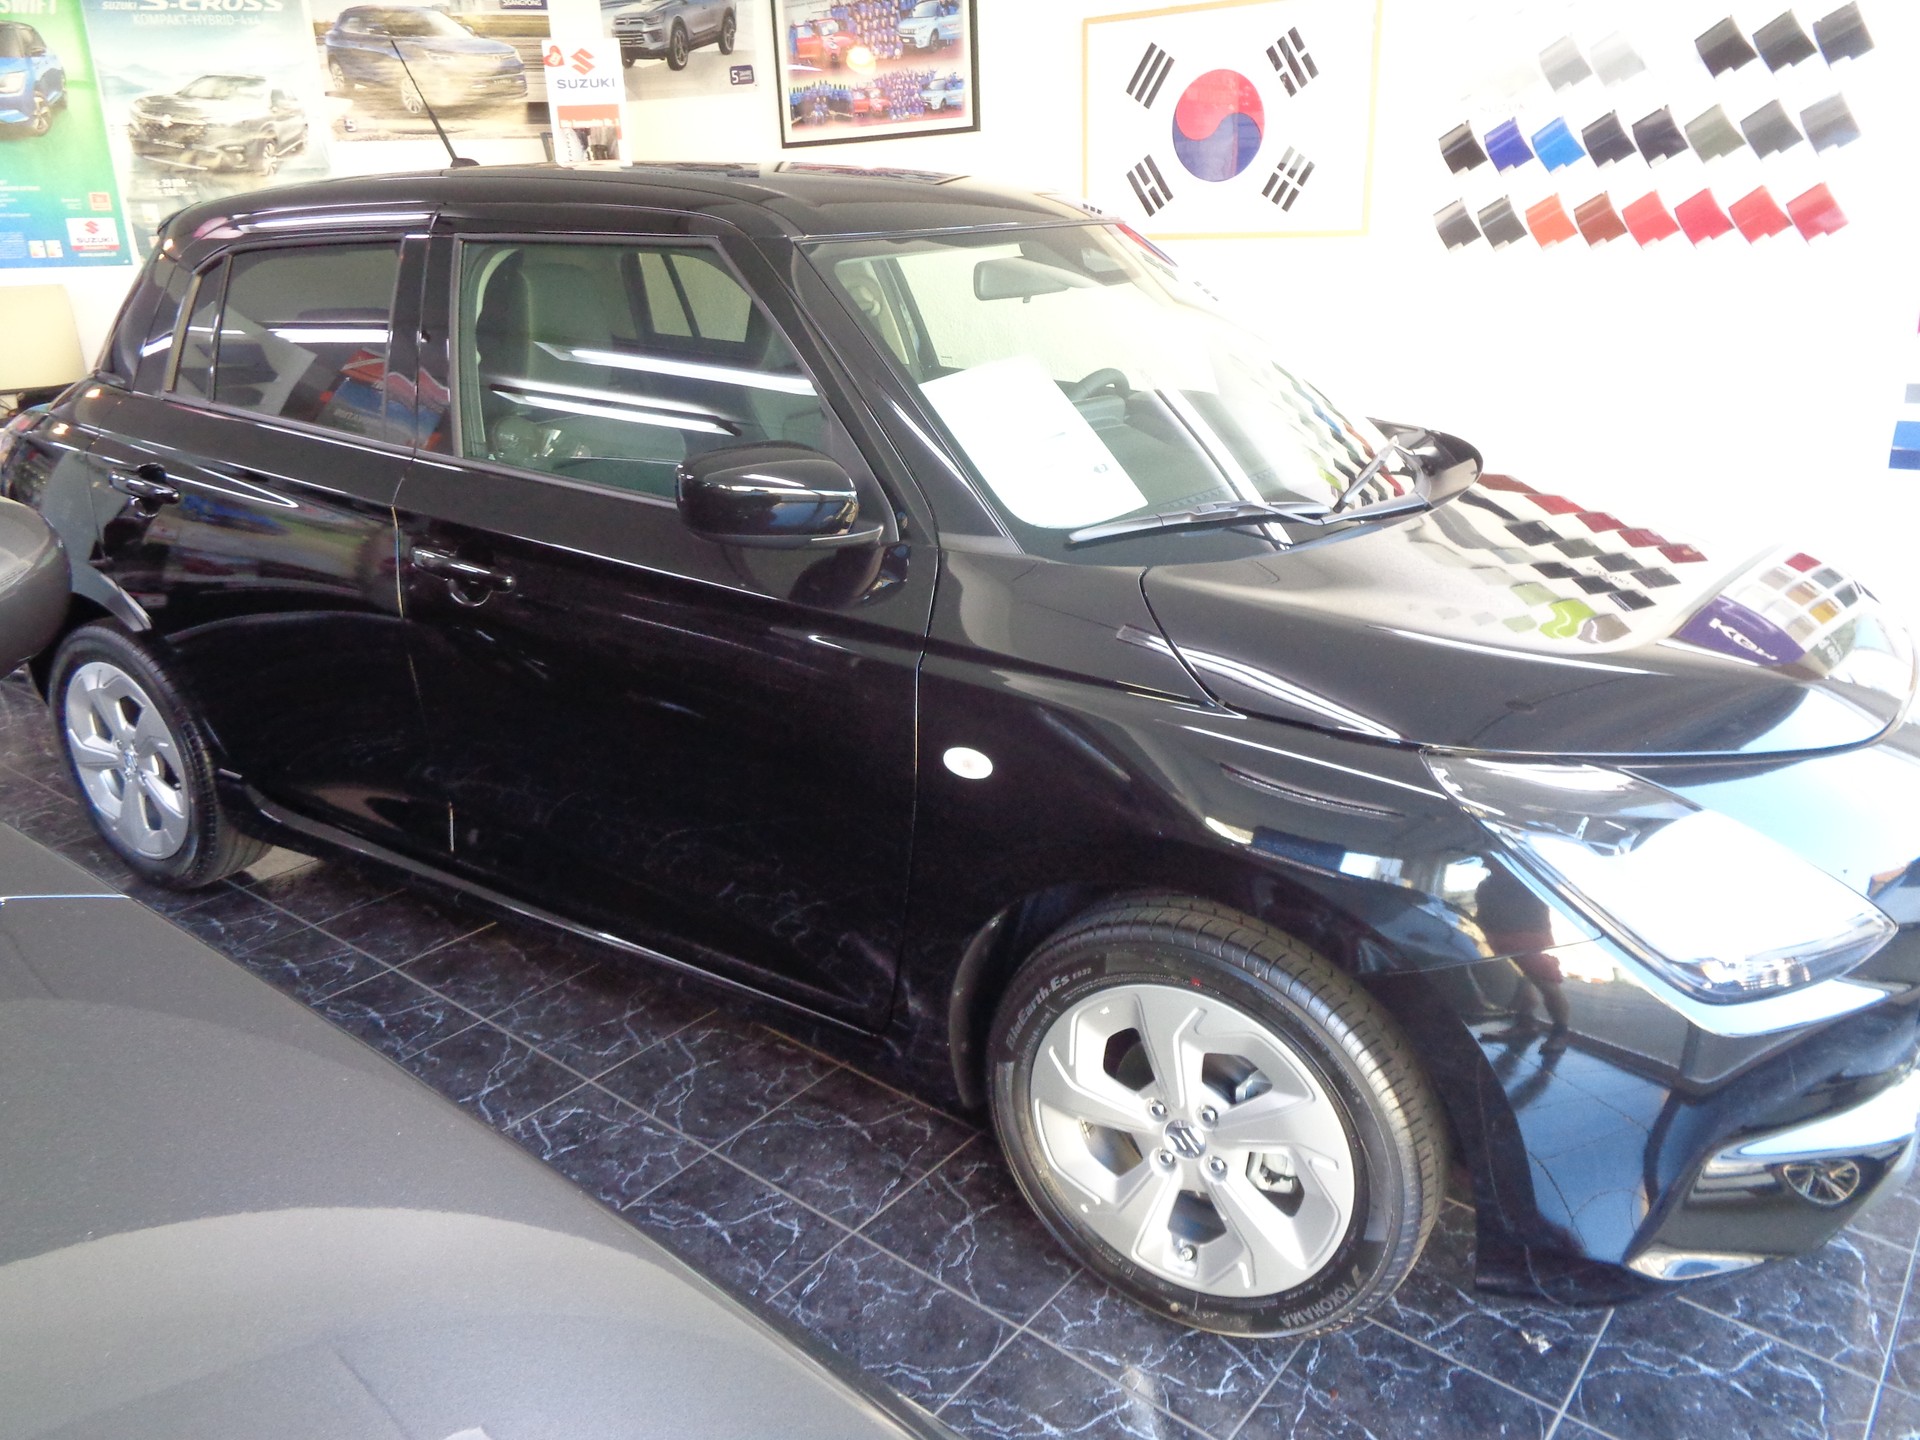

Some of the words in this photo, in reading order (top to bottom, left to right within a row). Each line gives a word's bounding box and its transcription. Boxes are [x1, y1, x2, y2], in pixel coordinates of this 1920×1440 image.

[731, 70, 739, 83] 5
[556, 78, 616, 89] SUZUKI
[1279, 1282, 1356, 1328] YOKOHAMA
